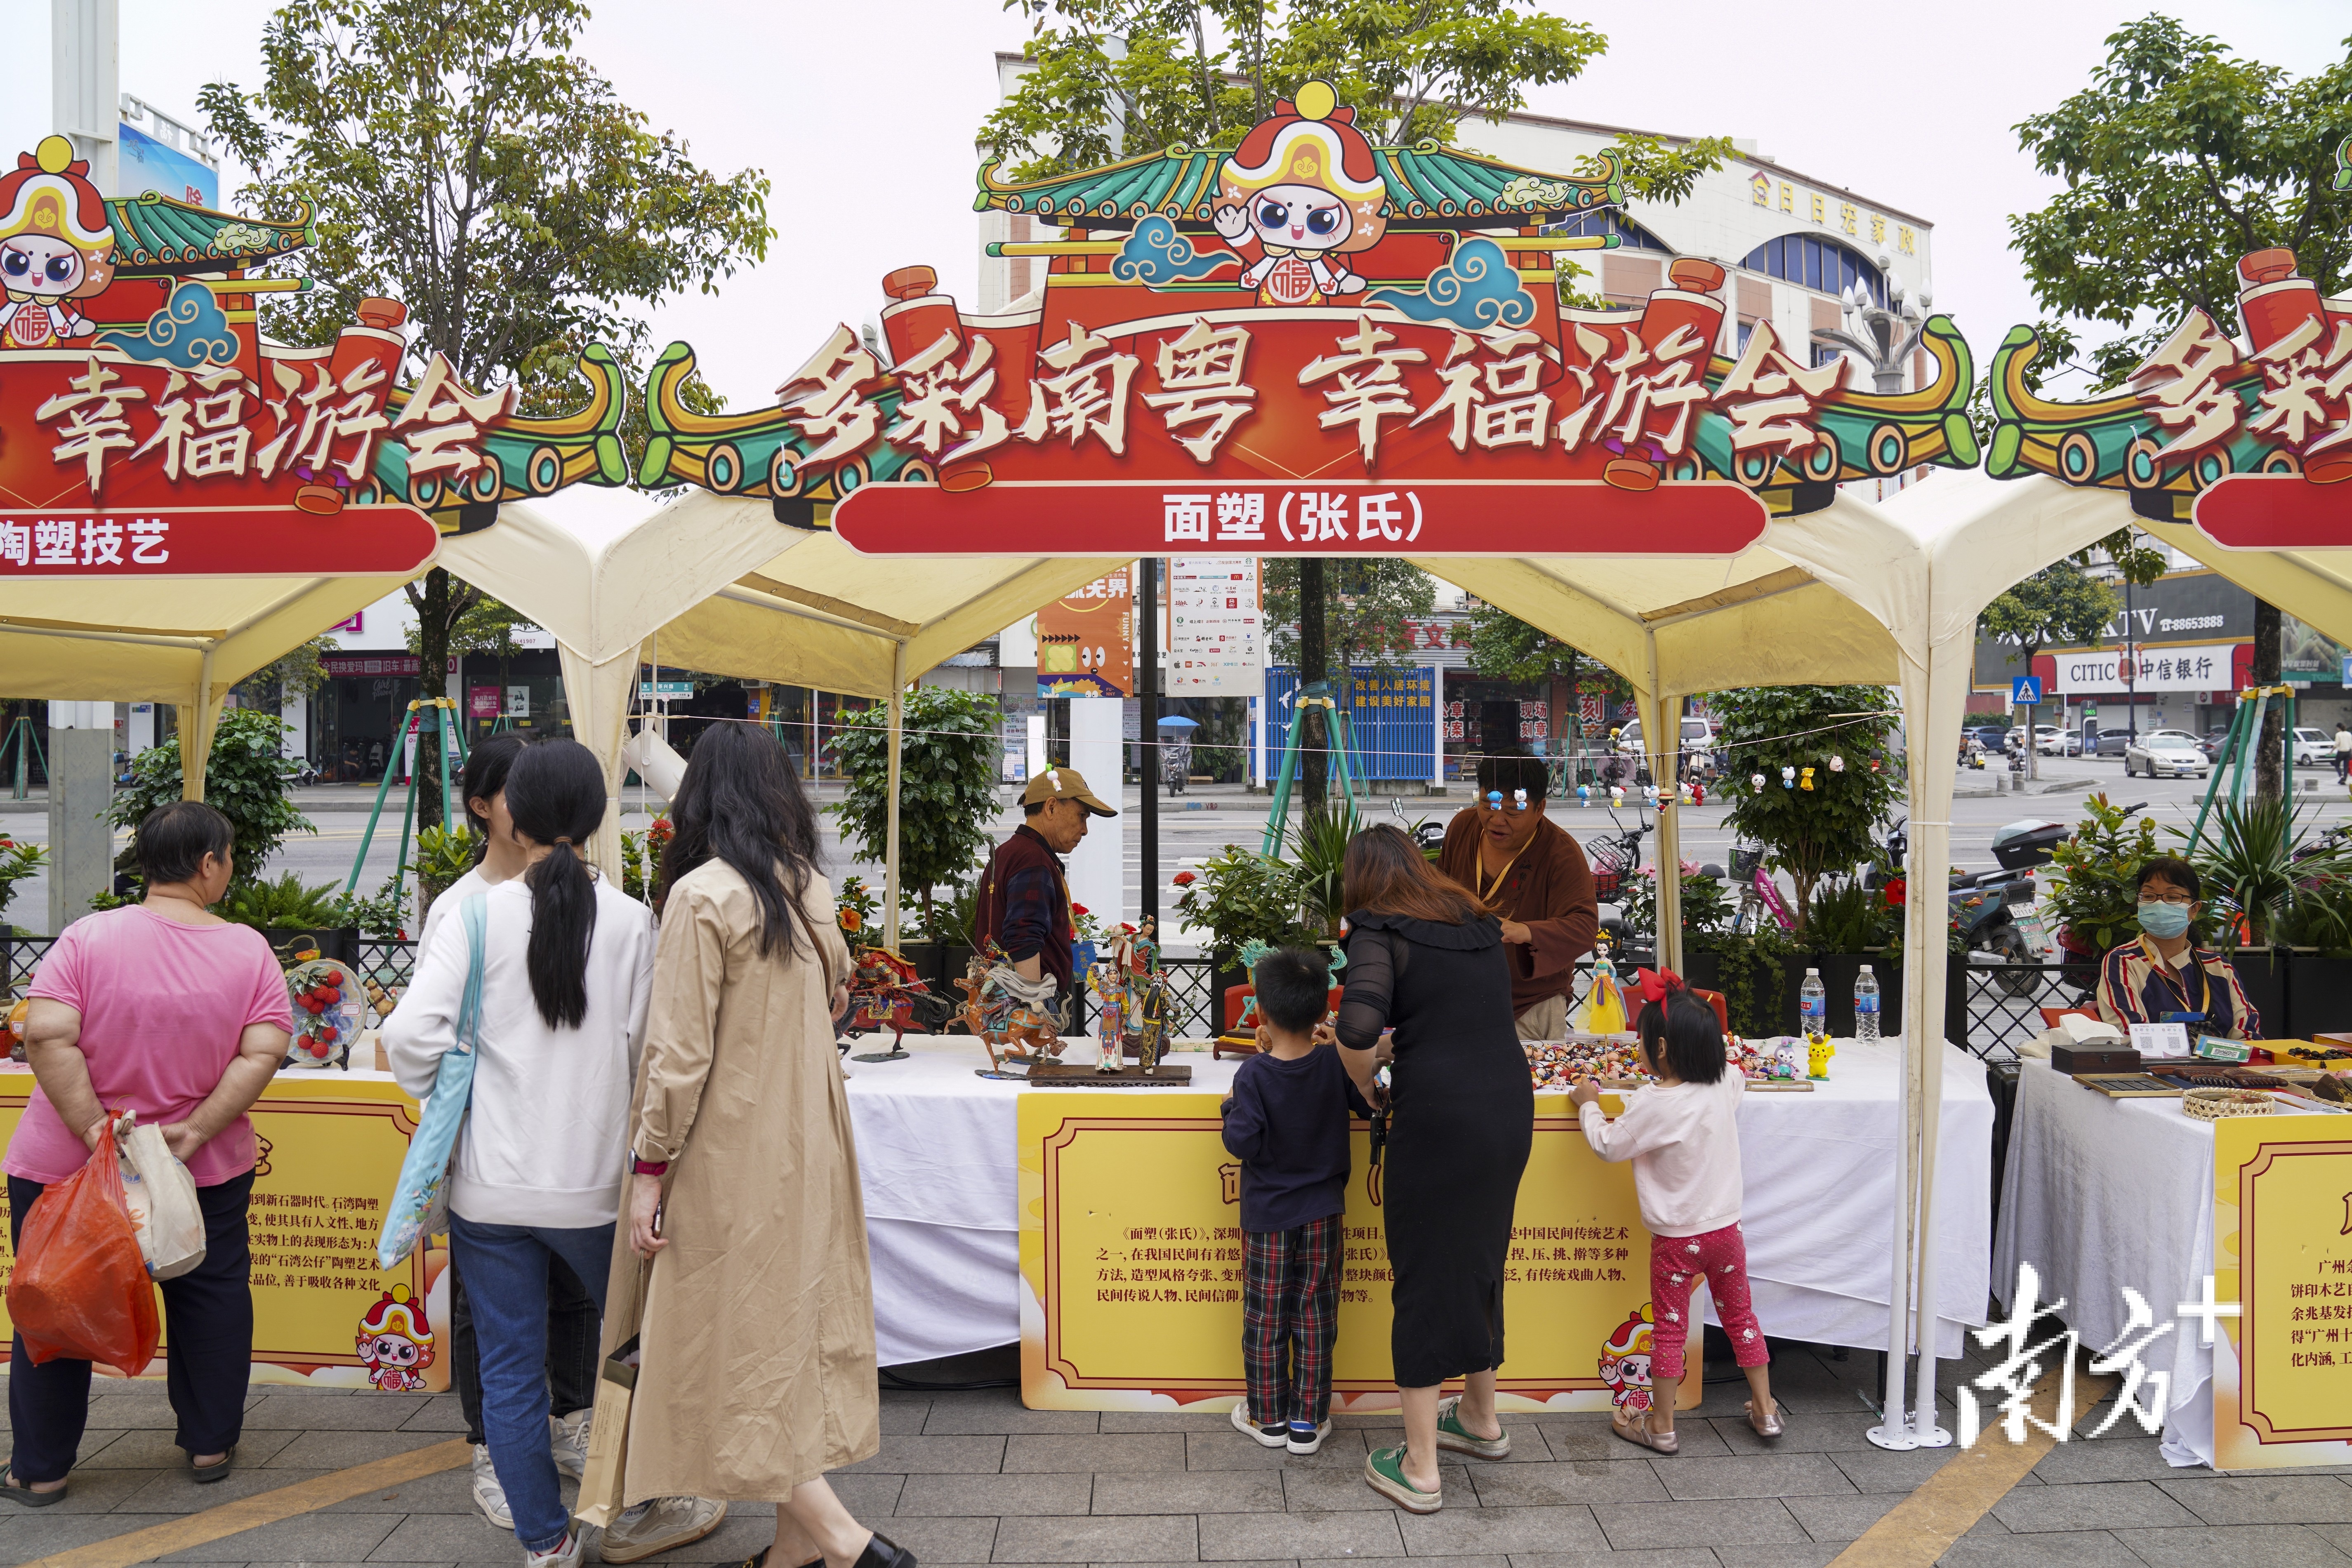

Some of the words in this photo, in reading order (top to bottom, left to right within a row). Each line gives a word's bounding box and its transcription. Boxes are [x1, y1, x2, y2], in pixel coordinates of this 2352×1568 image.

[1779, 181, 1916, 256] 日日宏家政
[1273, 258, 1315, 303] 福
[15, 305, 49, 342] 福
[775, 316, 1259, 473] 多彩南粤
[1298, 313, 1847, 474] 幸福游会
[35, 350, 514, 504] 幸福游会
[1162, 491, 1423, 543] 面塑（张氏）
[0, 518, 170, 567] 陶塑技艺
[2173, 615, 2223, 631] 88653888
[383, 660, 400, 672] 旧车
[2071, 663, 2115, 681] CITIC
[2140, 656, 2213, 682] 中信银行
[1355, 680, 1431, 691] 改善人居环境
[1355, 696, 1431, 707] 建设美好家园
[1520, 701, 1548, 719] 现场
[1520, 720, 1548, 738] 刻章
[1079, 950, 1089, 969] 参展证
[383, 1369, 402, 1390] 福
